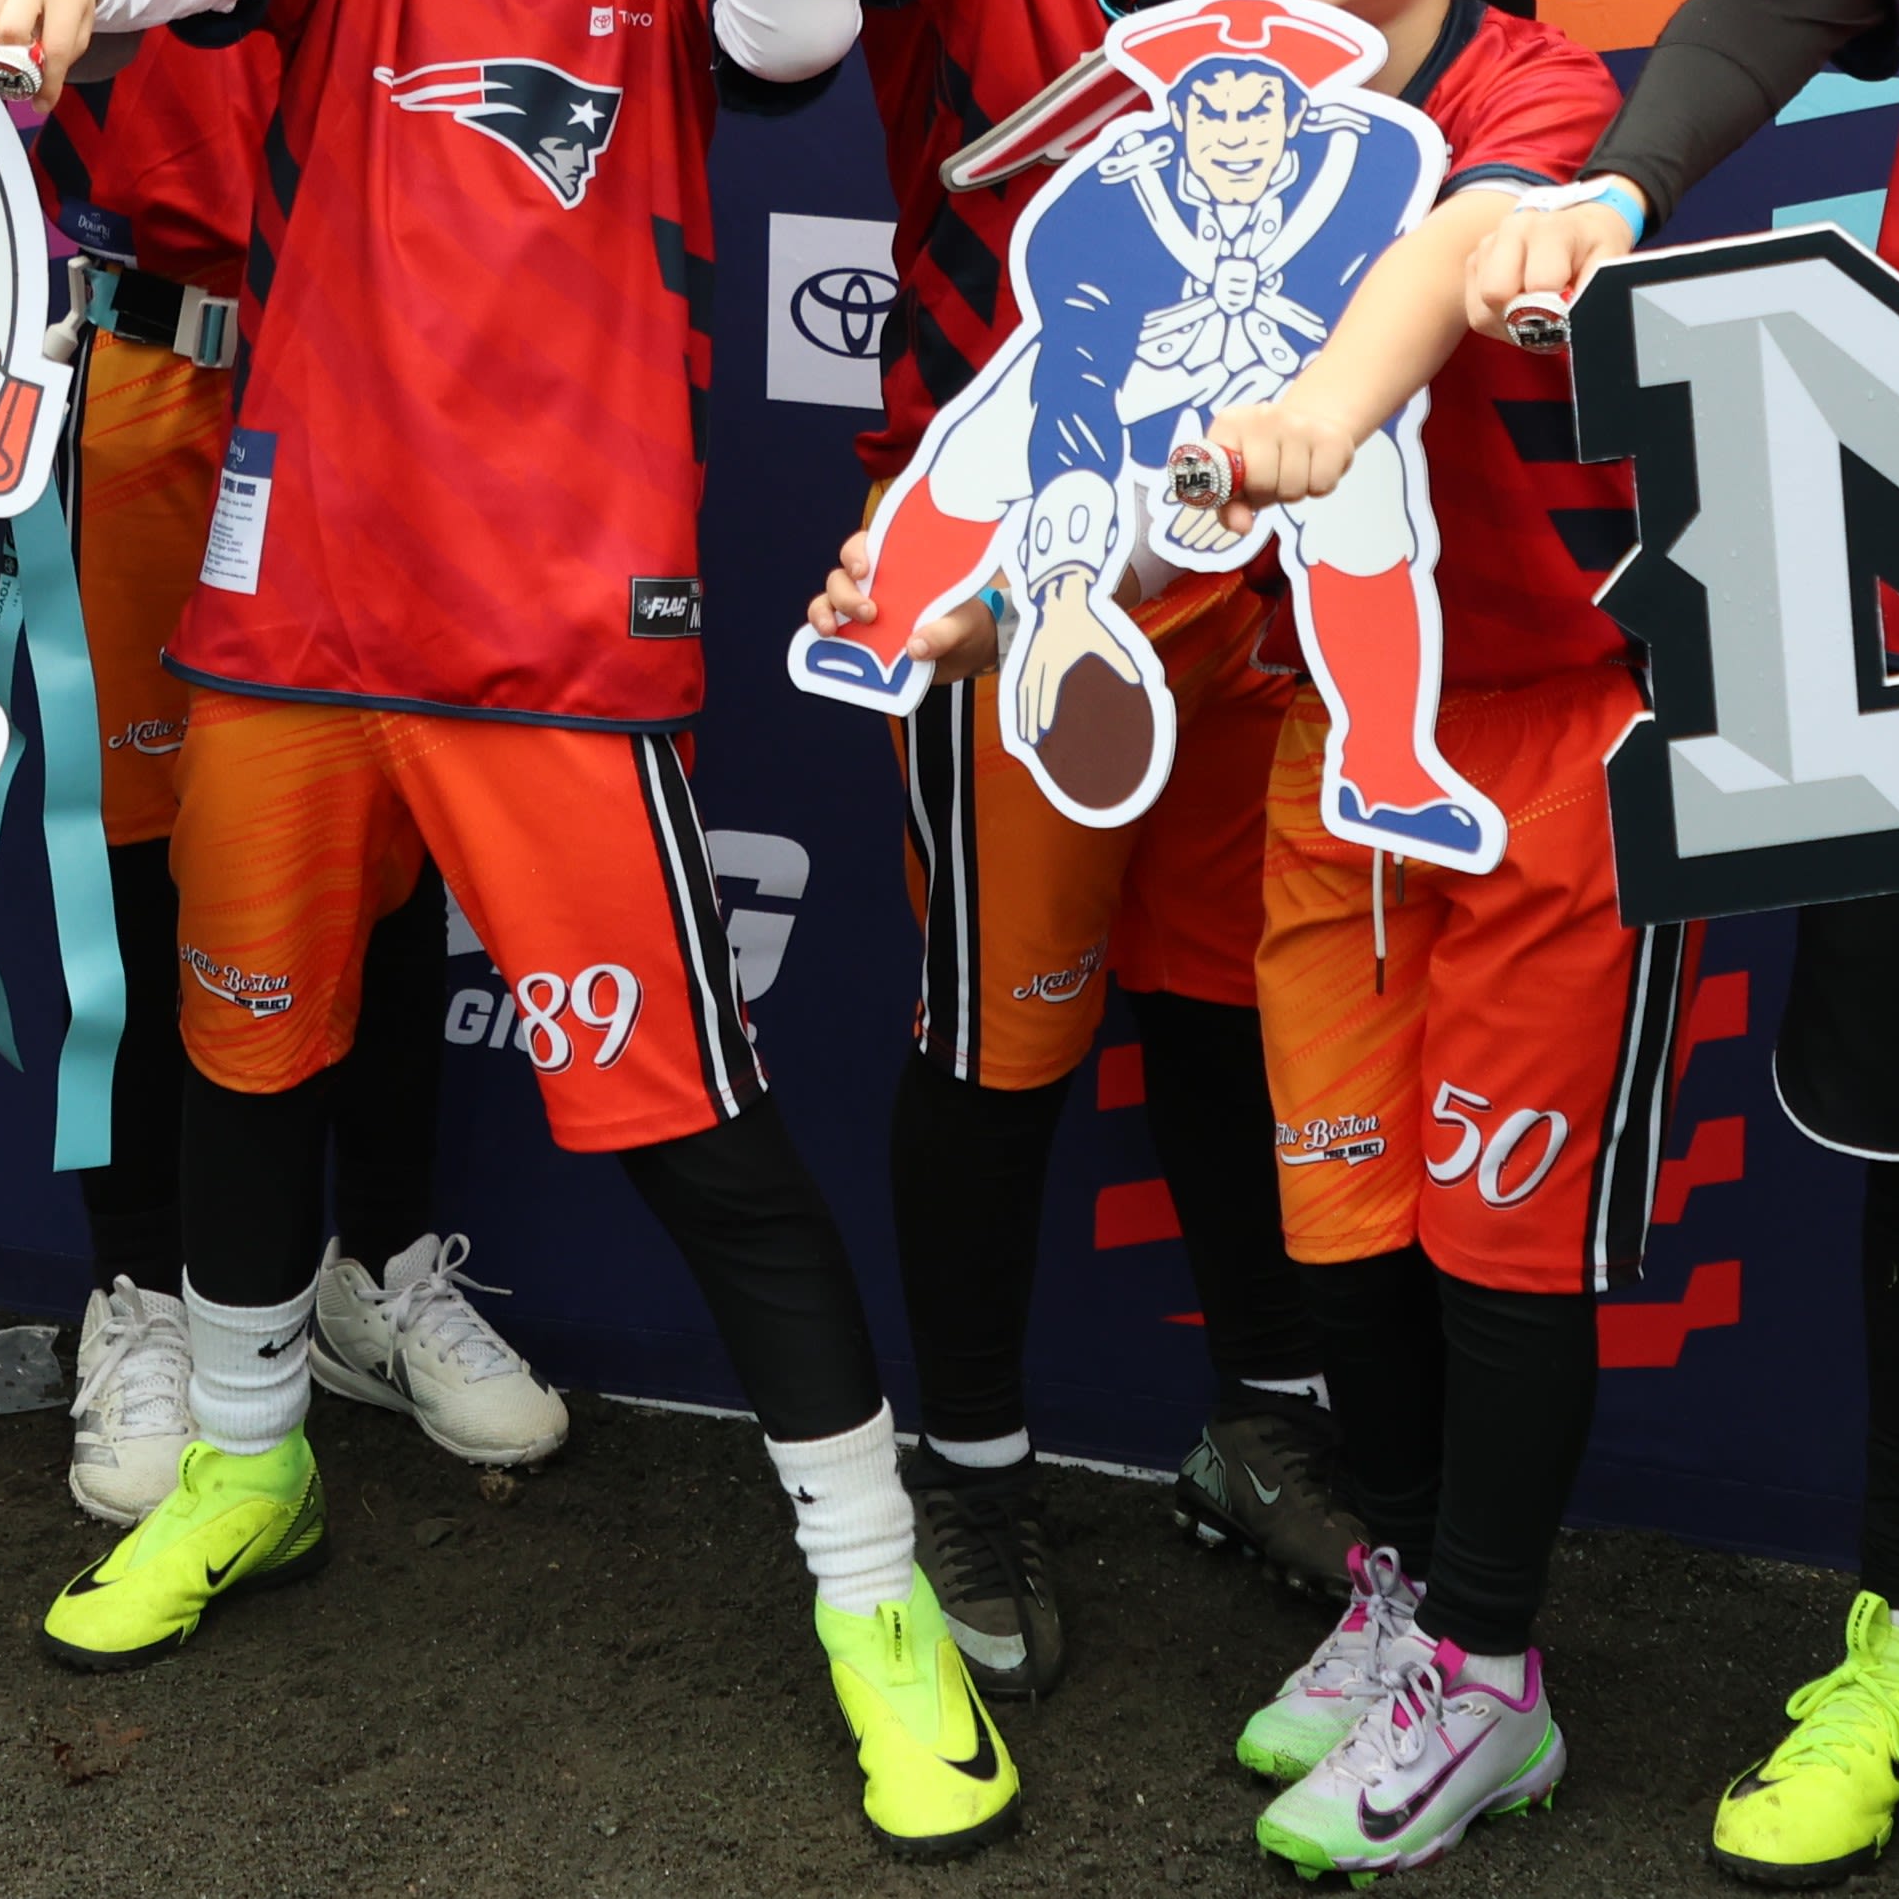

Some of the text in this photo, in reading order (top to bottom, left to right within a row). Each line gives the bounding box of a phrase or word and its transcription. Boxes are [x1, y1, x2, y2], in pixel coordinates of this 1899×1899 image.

[646, 596, 688, 620] FLAG
[222, 964, 289, 993] Boston
[515, 962, 644, 1076] 89
[1303, 1113, 1379, 1151] Boston
[1424, 1080, 1571, 1211] 50
